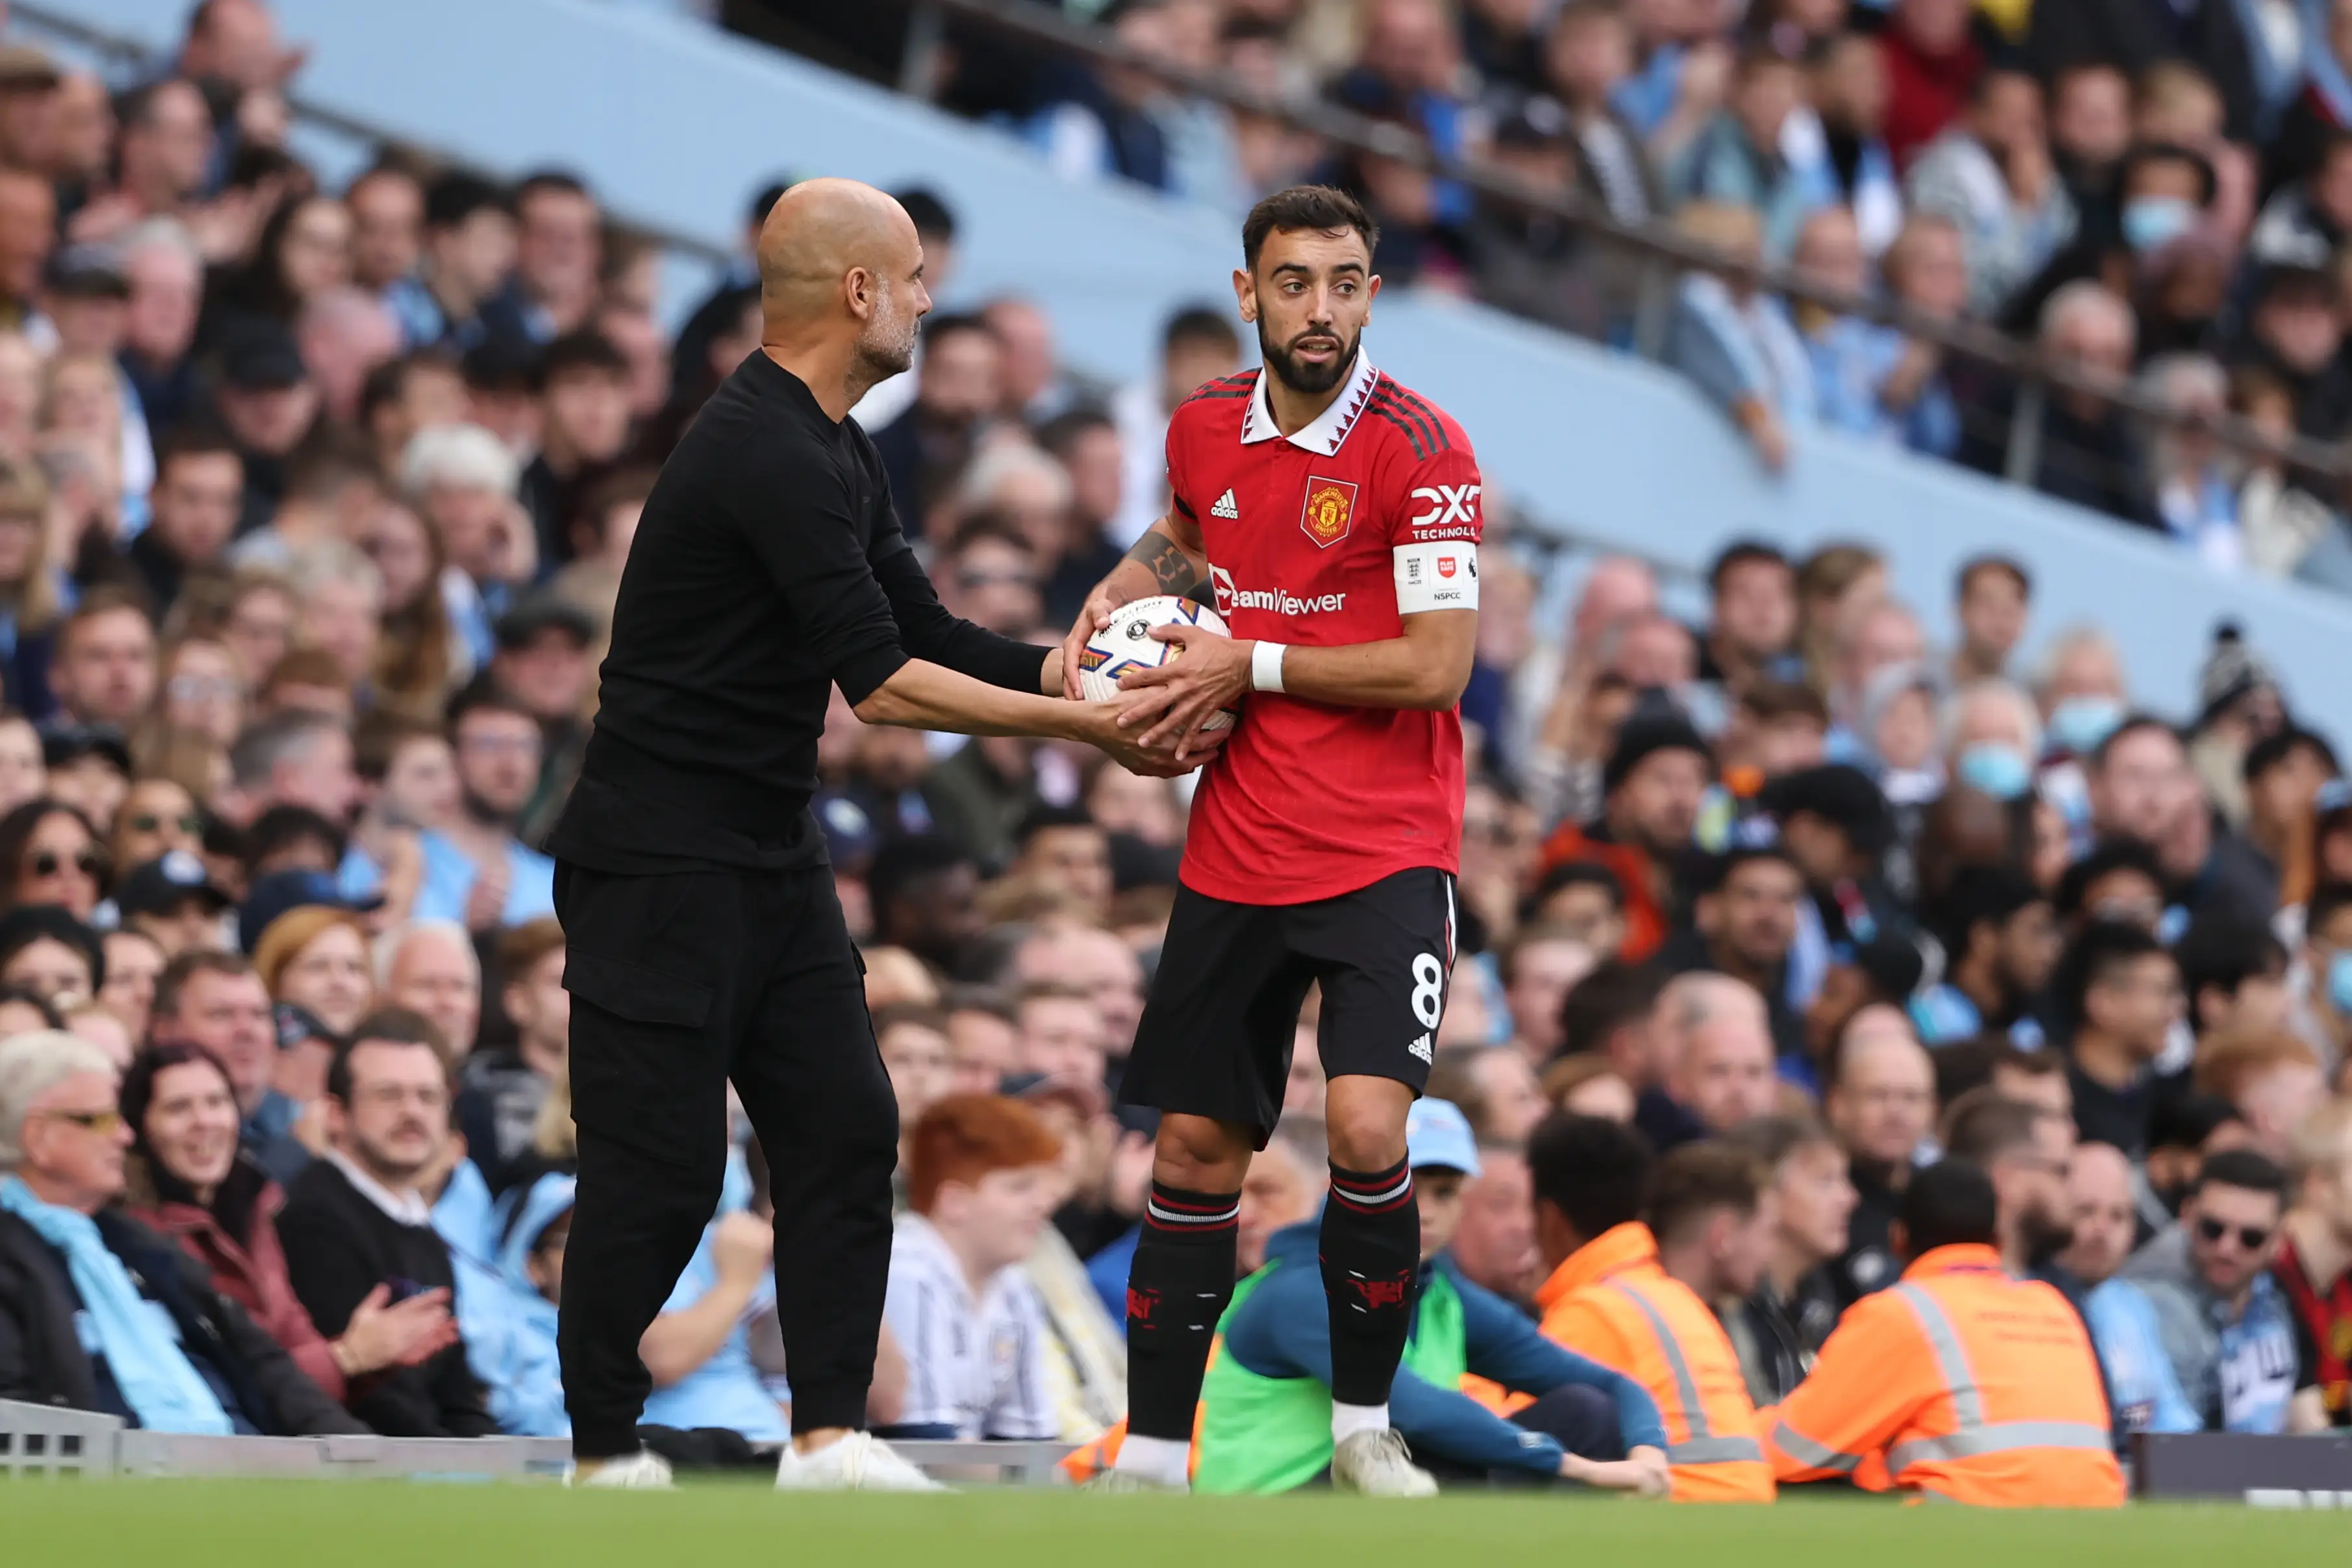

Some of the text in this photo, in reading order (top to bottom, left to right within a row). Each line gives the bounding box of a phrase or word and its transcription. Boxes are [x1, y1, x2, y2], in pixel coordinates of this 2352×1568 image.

[1211, 506, 1238, 519] adidas
[1315, 523, 1337, 533] UNITED
[1231, 587, 1346, 615] eamViewer
[1434, 592, 1461, 601] NSPCC
[1411, 953, 1442, 1030] 8
